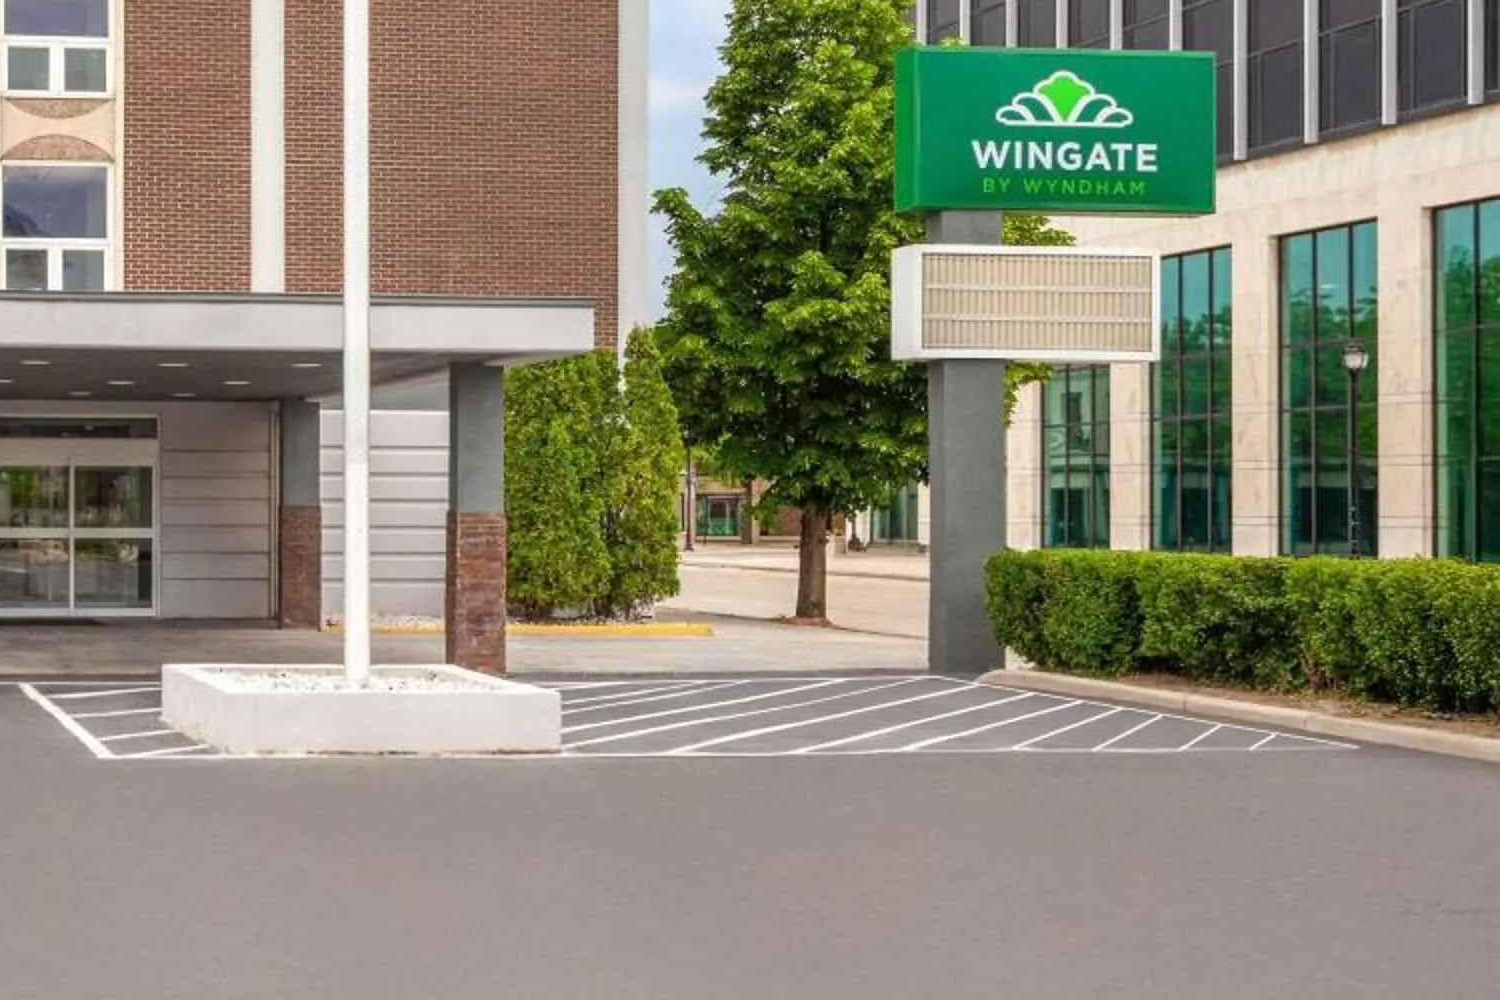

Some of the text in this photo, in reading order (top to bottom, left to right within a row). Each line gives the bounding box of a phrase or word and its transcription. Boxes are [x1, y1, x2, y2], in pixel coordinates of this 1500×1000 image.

[971, 139, 1158, 172] WINGATE
[983, 178, 1146, 195] BY WYNDHAM
